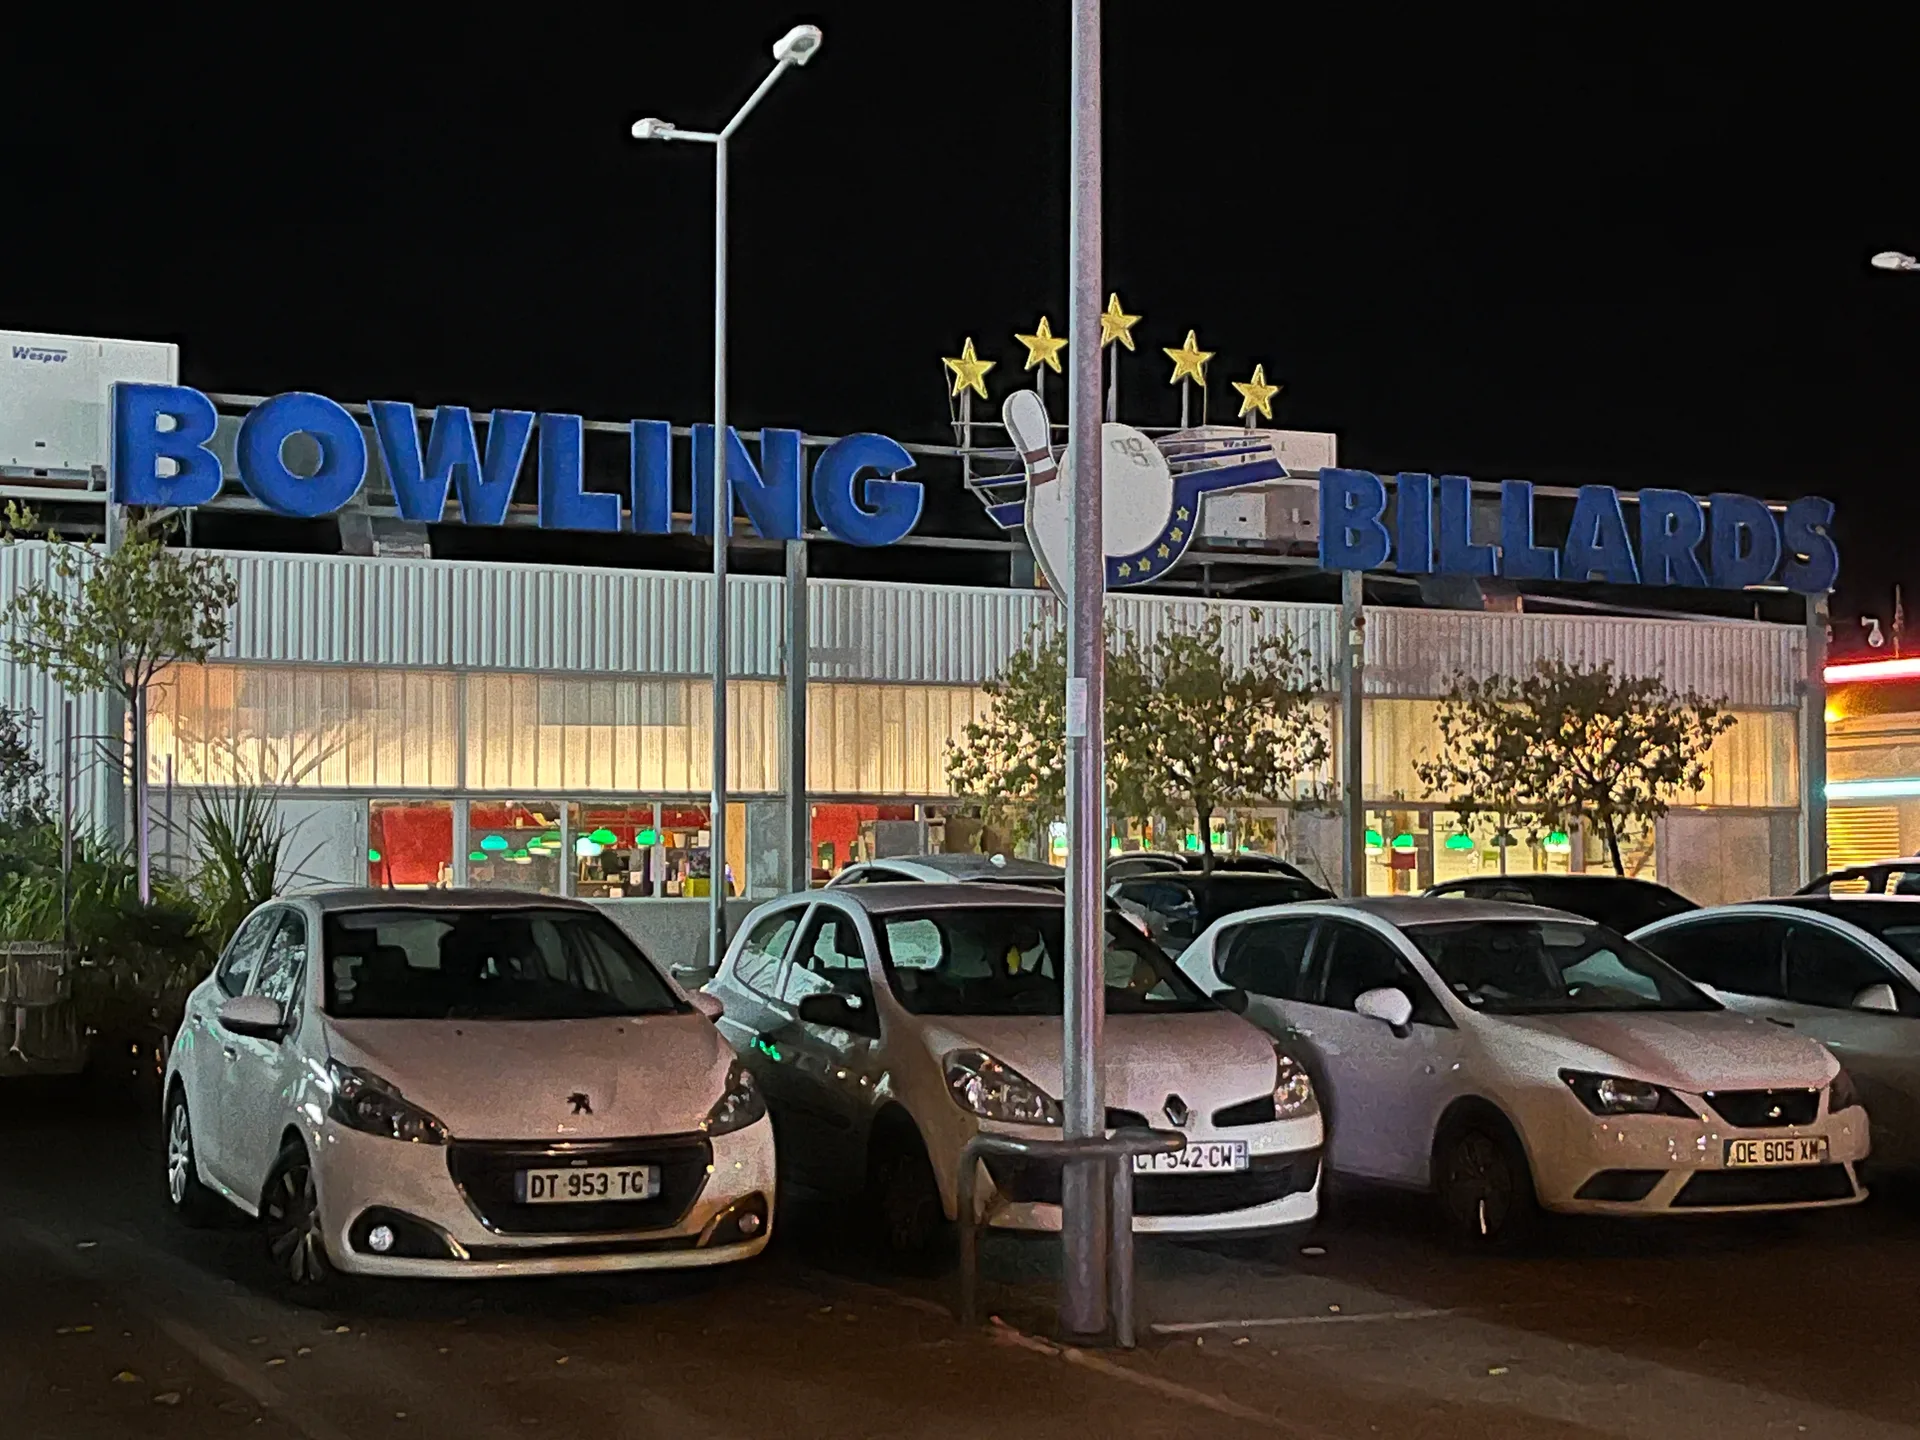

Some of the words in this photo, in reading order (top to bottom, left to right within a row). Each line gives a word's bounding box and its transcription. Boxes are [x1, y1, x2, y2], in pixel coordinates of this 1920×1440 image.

[108, 380, 925, 547] BOWLING
[1318, 466, 1840, 594] BILLARDS
[531, 1174, 559, 1199] DT
[568, 1172, 609, 1197] 953
